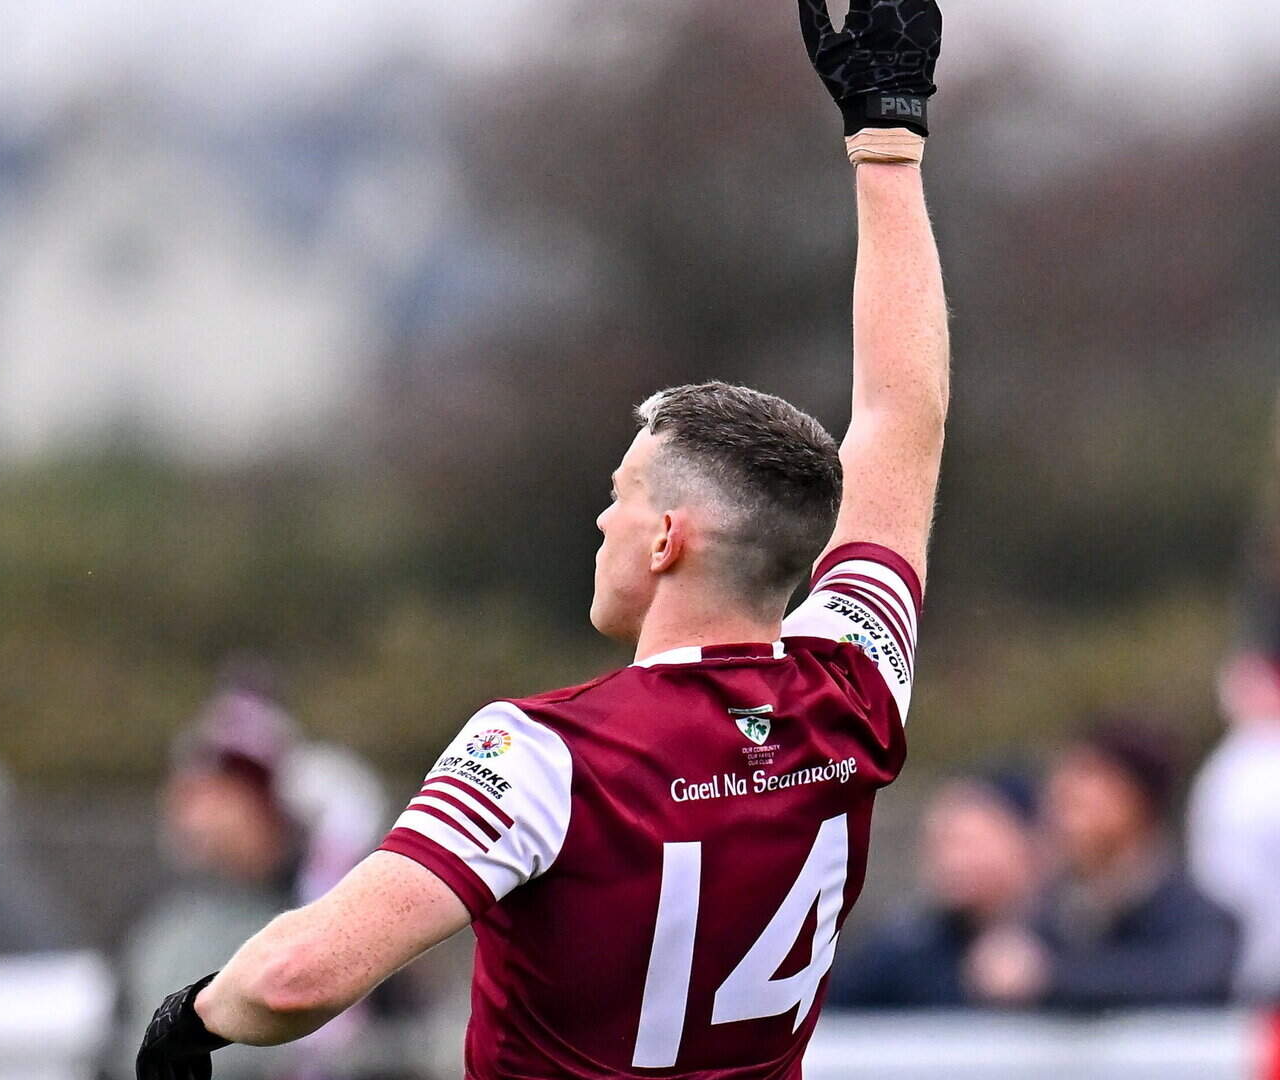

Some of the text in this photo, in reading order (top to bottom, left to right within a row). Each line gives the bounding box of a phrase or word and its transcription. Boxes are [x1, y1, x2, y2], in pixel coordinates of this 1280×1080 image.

[830, 596, 884, 632] DECORATORS
[823, 600, 906, 685] IVOR PARKE
[457, 770, 503, 800] DECORATORS
[460, 760, 513, 793] PARKE
[670, 774, 721, 803] Gaeil
[723, 772, 748, 797] Na
[631, 812, 849, 1069] 14
